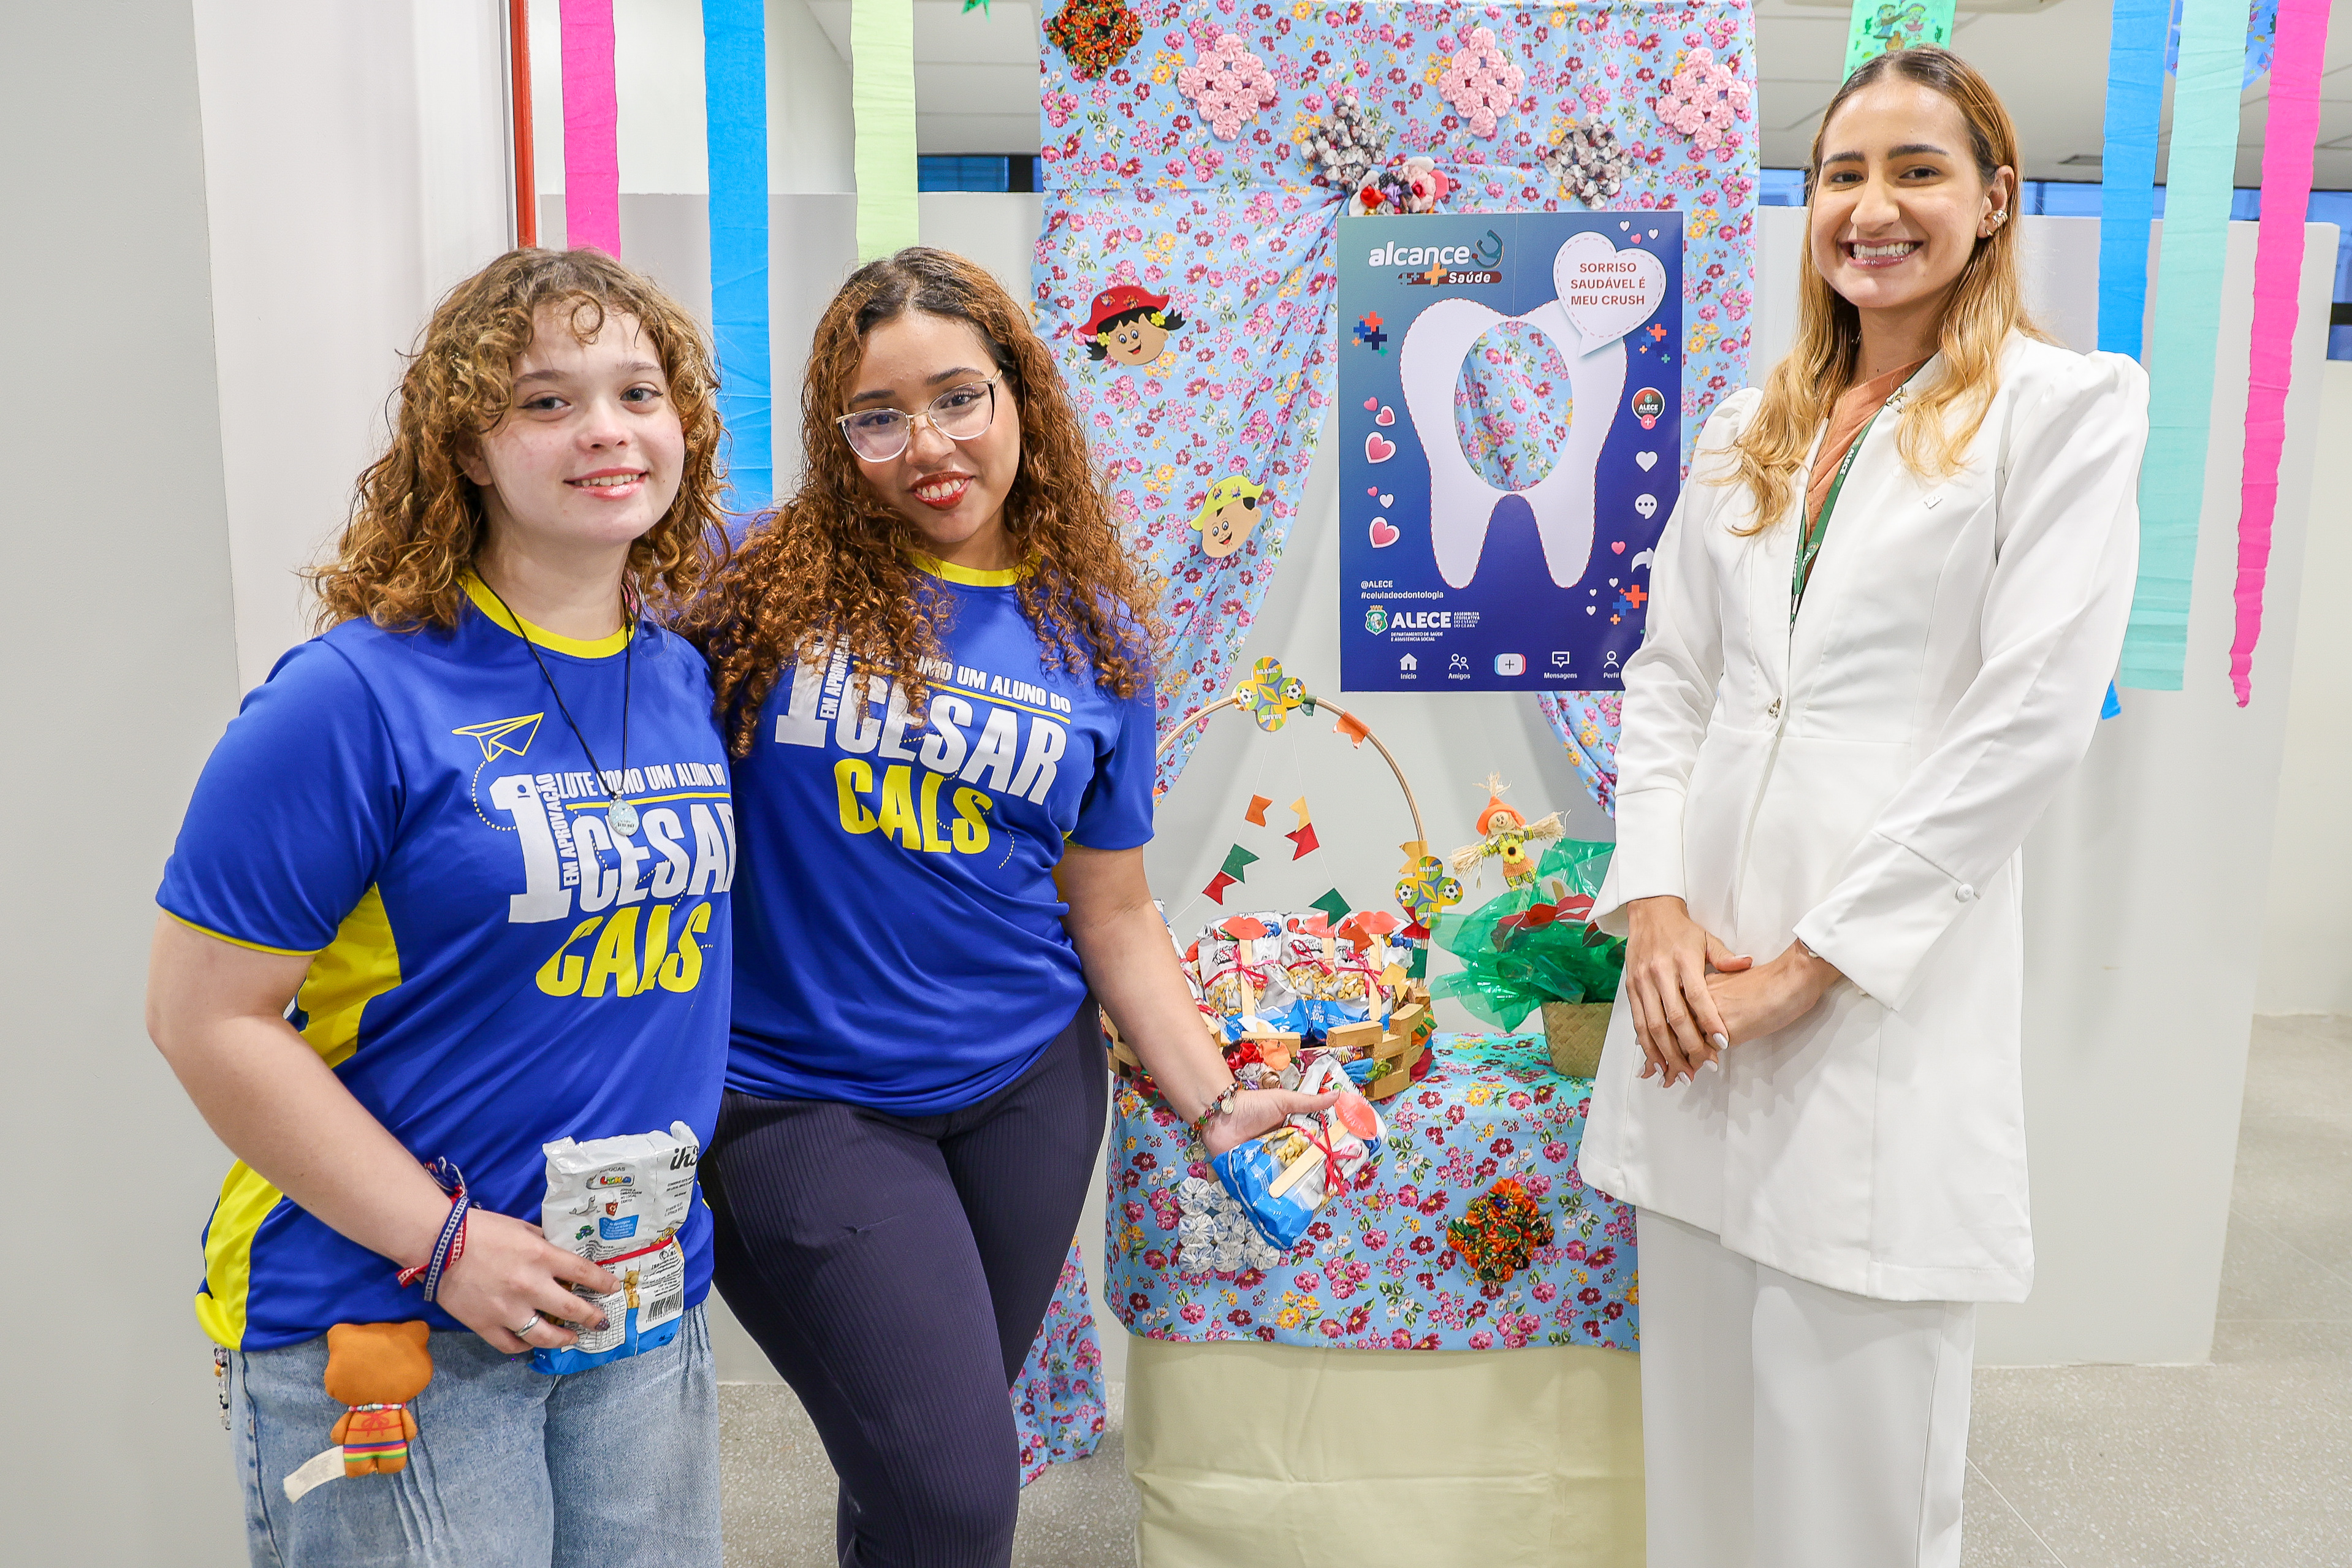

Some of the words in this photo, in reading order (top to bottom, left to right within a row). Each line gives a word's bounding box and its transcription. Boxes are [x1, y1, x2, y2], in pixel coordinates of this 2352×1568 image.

[1368, 240, 1471, 267] alcance
[1448, 271, 1491, 284] Saúde
[1580, 262, 1637, 273] SORRISO
[1570, 276, 1635, 289] SAUDÁVEL
[1639, 276, 1646, 289] É
[1571, 295, 1598, 305] MEU
[1602, 295, 1645, 305] CRUSH
[1361, 580, 1393, 589] @ALECE
[1361, 590, 1444, 600] #celuladeodontologia
[1391, 612, 1452, 628] ALECE
[956, 665, 988, 691] UM
[989, 674, 1047, 707] ALUNO
[1049, 691, 1071, 714] DO
[820, 696, 840, 720] EM
[555, 771, 599, 799] LUTE
[595, 767, 646, 796] COMO
[644, 764, 677, 791] UM
[674, 763, 712, 787] ALUNO
[707, 763, 726, 786] DO
[535, 773, 577, 858] APROVAÇÃO
[834, 757, 993, 854] CALS
[561, 860, 580, 887] EM
[536, 901, 712, 998] CALS
